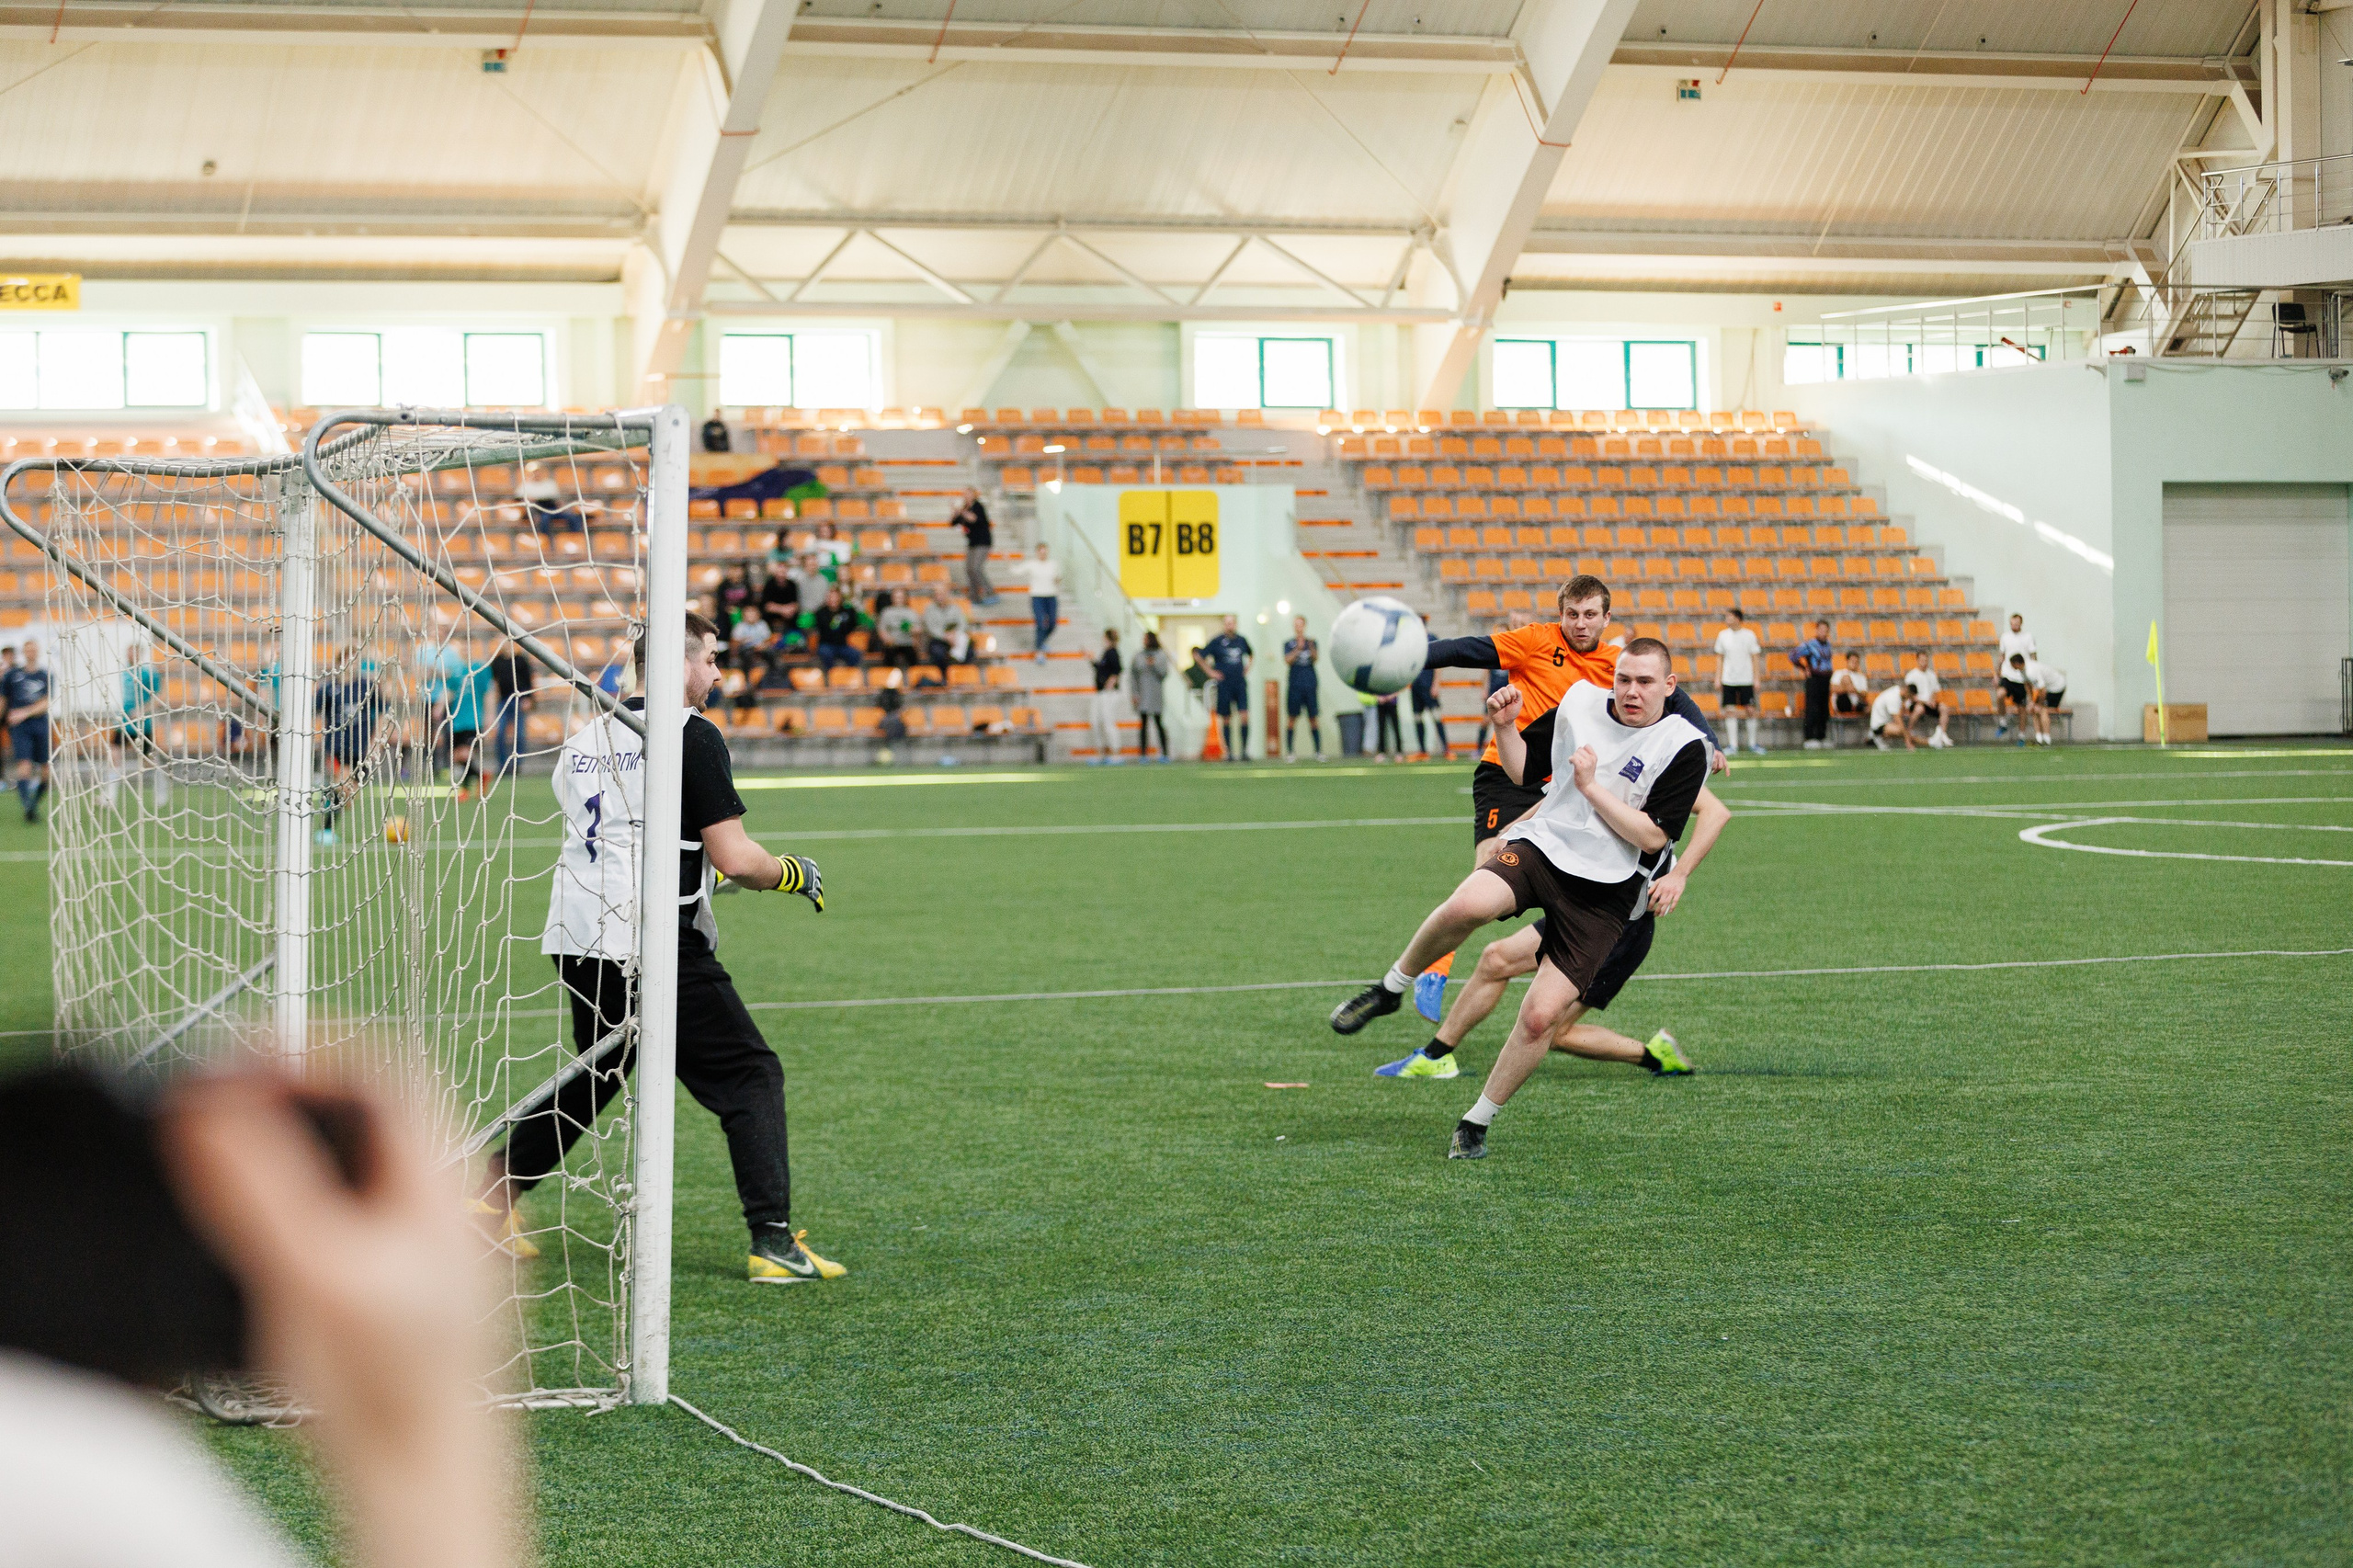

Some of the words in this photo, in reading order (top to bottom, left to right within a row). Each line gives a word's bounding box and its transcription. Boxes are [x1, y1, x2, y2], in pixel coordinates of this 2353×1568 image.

[1128, 522, 1162, 556] B7
[1176, 522, 1214, 555] B8
[1552, 646, 1566, 667] 5
[1486, 808, 1500, 829] 5
